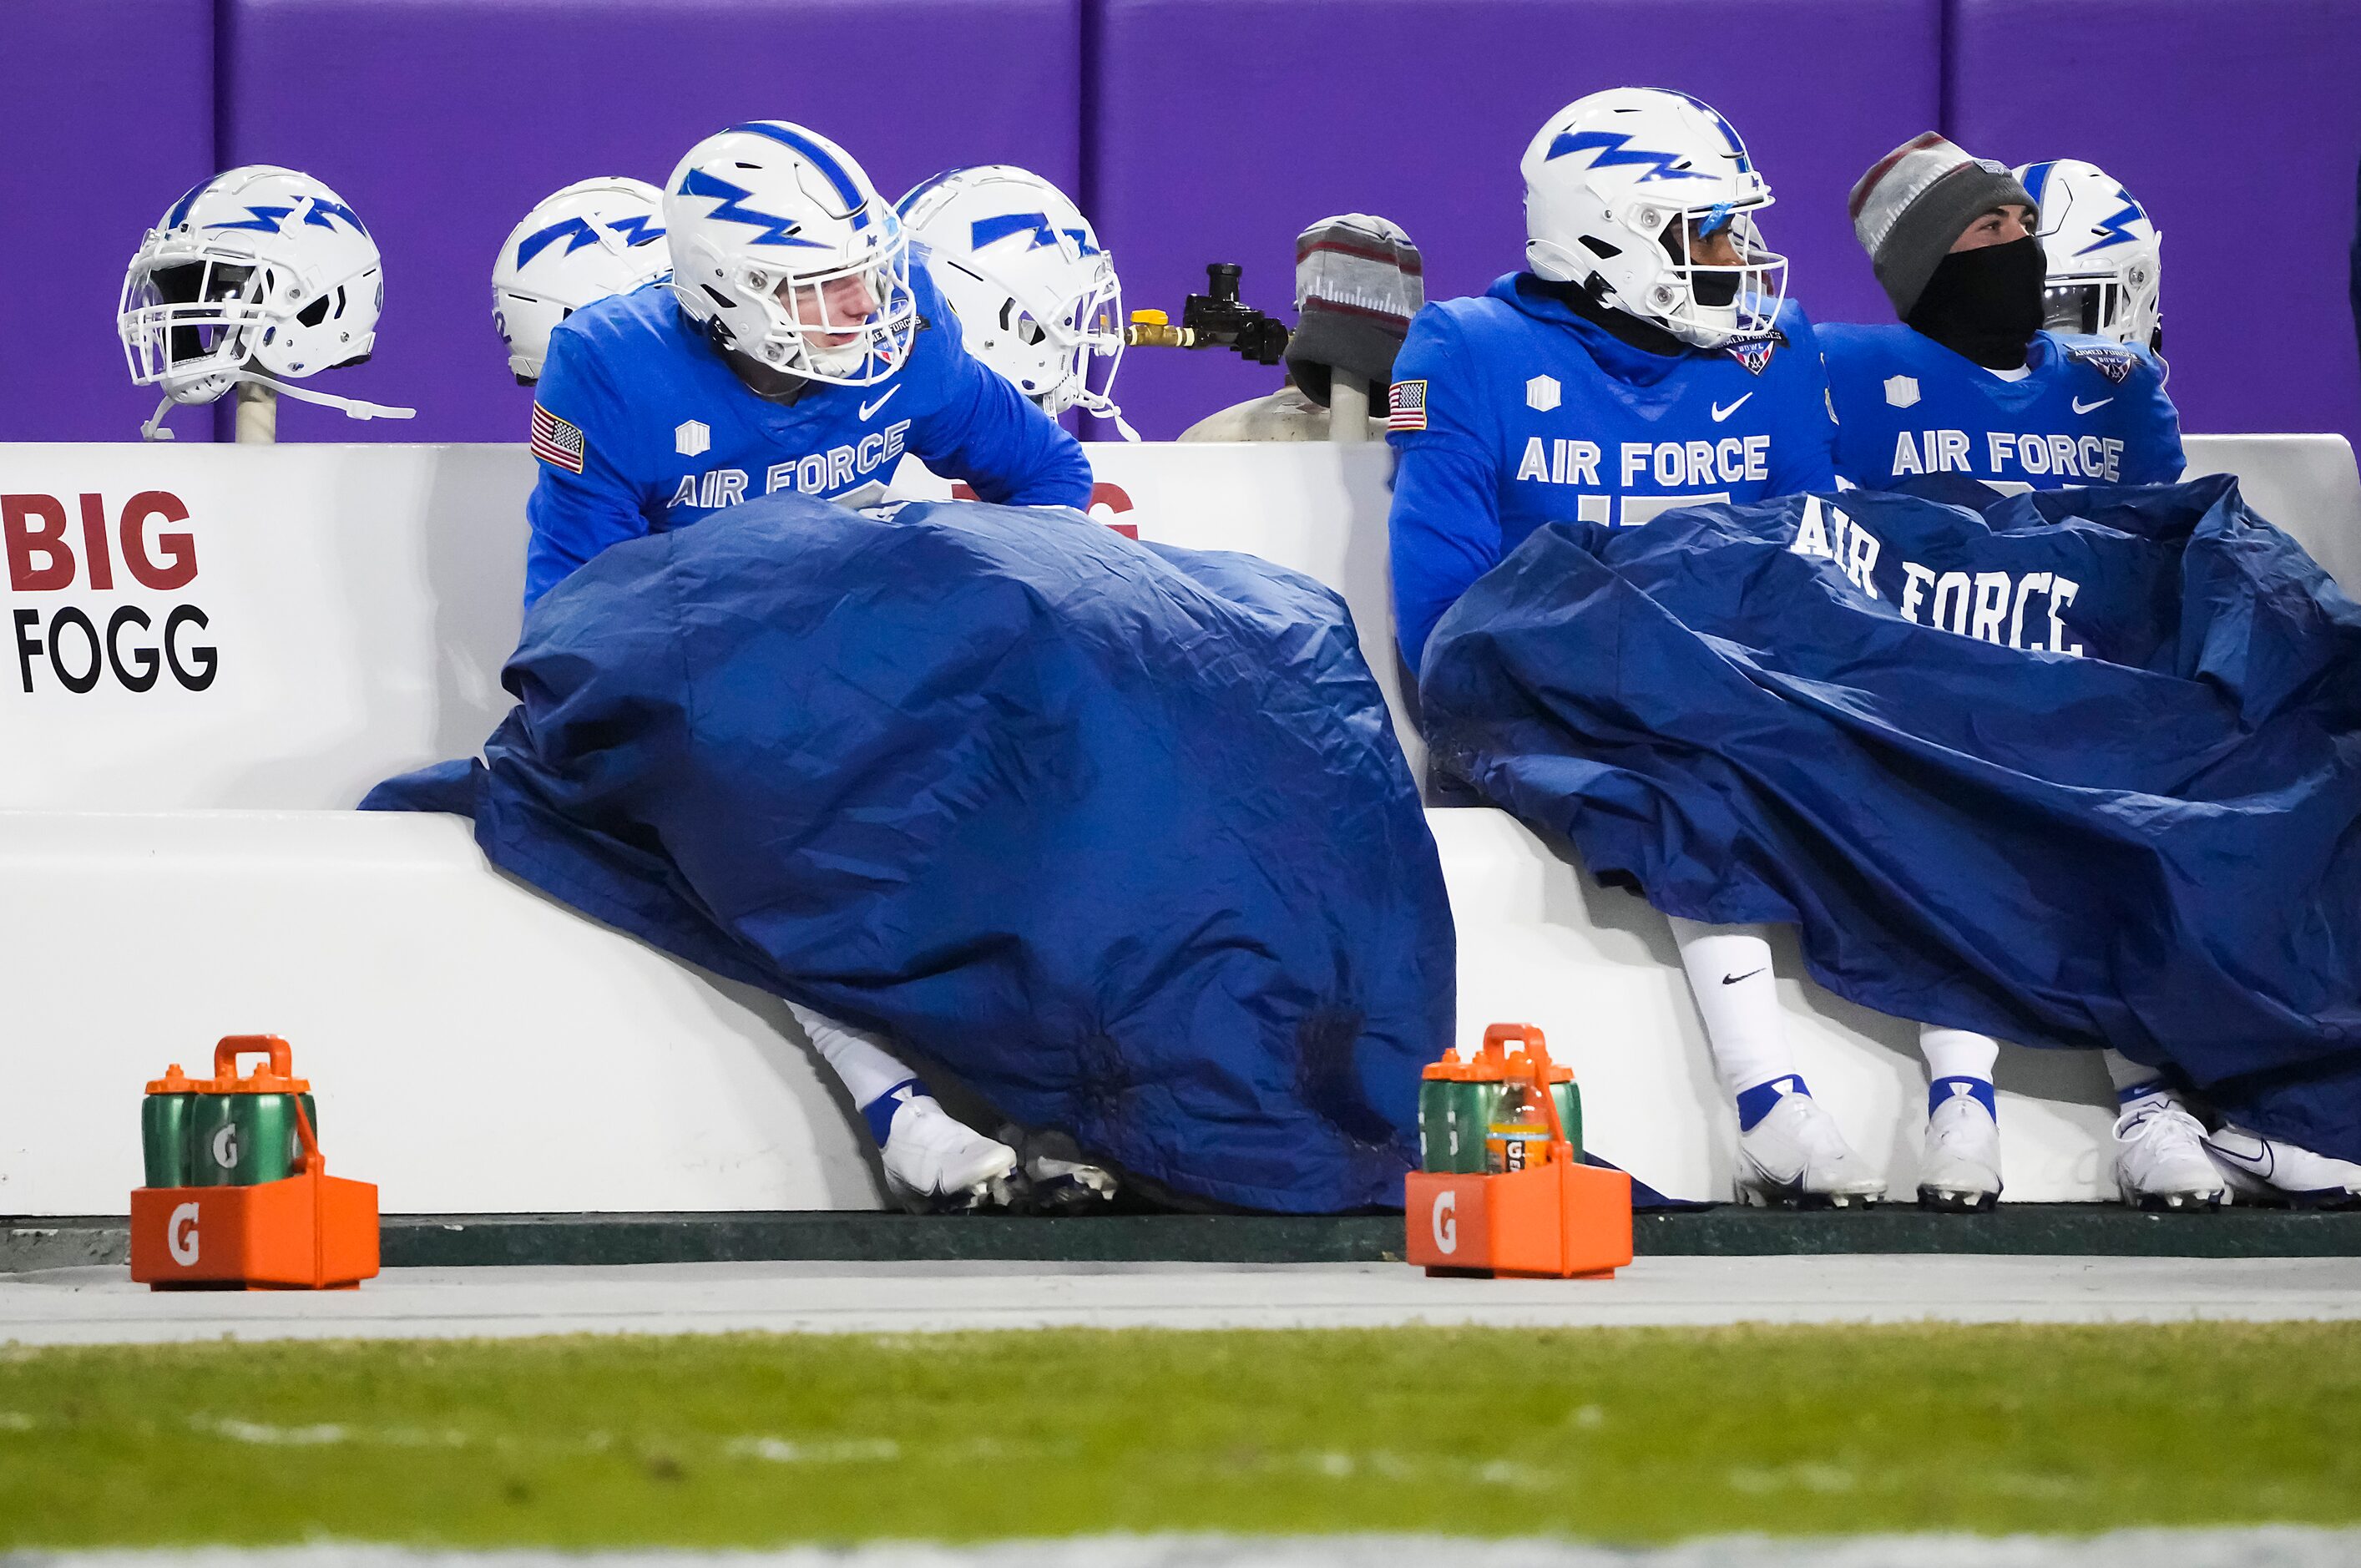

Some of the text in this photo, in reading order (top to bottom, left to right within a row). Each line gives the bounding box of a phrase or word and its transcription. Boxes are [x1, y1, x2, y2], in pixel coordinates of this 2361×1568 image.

[666, 418, 911, 508] AIR FORCE
[1516, 435, 1770, 487] AIR FORCE
[1892, 429, 2124, 483] AIR FORCE
[1, 491, 198, 591] BIG
[1790, 494, 2084, 658] AIR FORCE
[13, 604, 218, 694] FOGG
[213, 1122, 238, 1169] G
[168, 1201, 200, 1267] G
[1433, 1191, 1457, 1255] G
